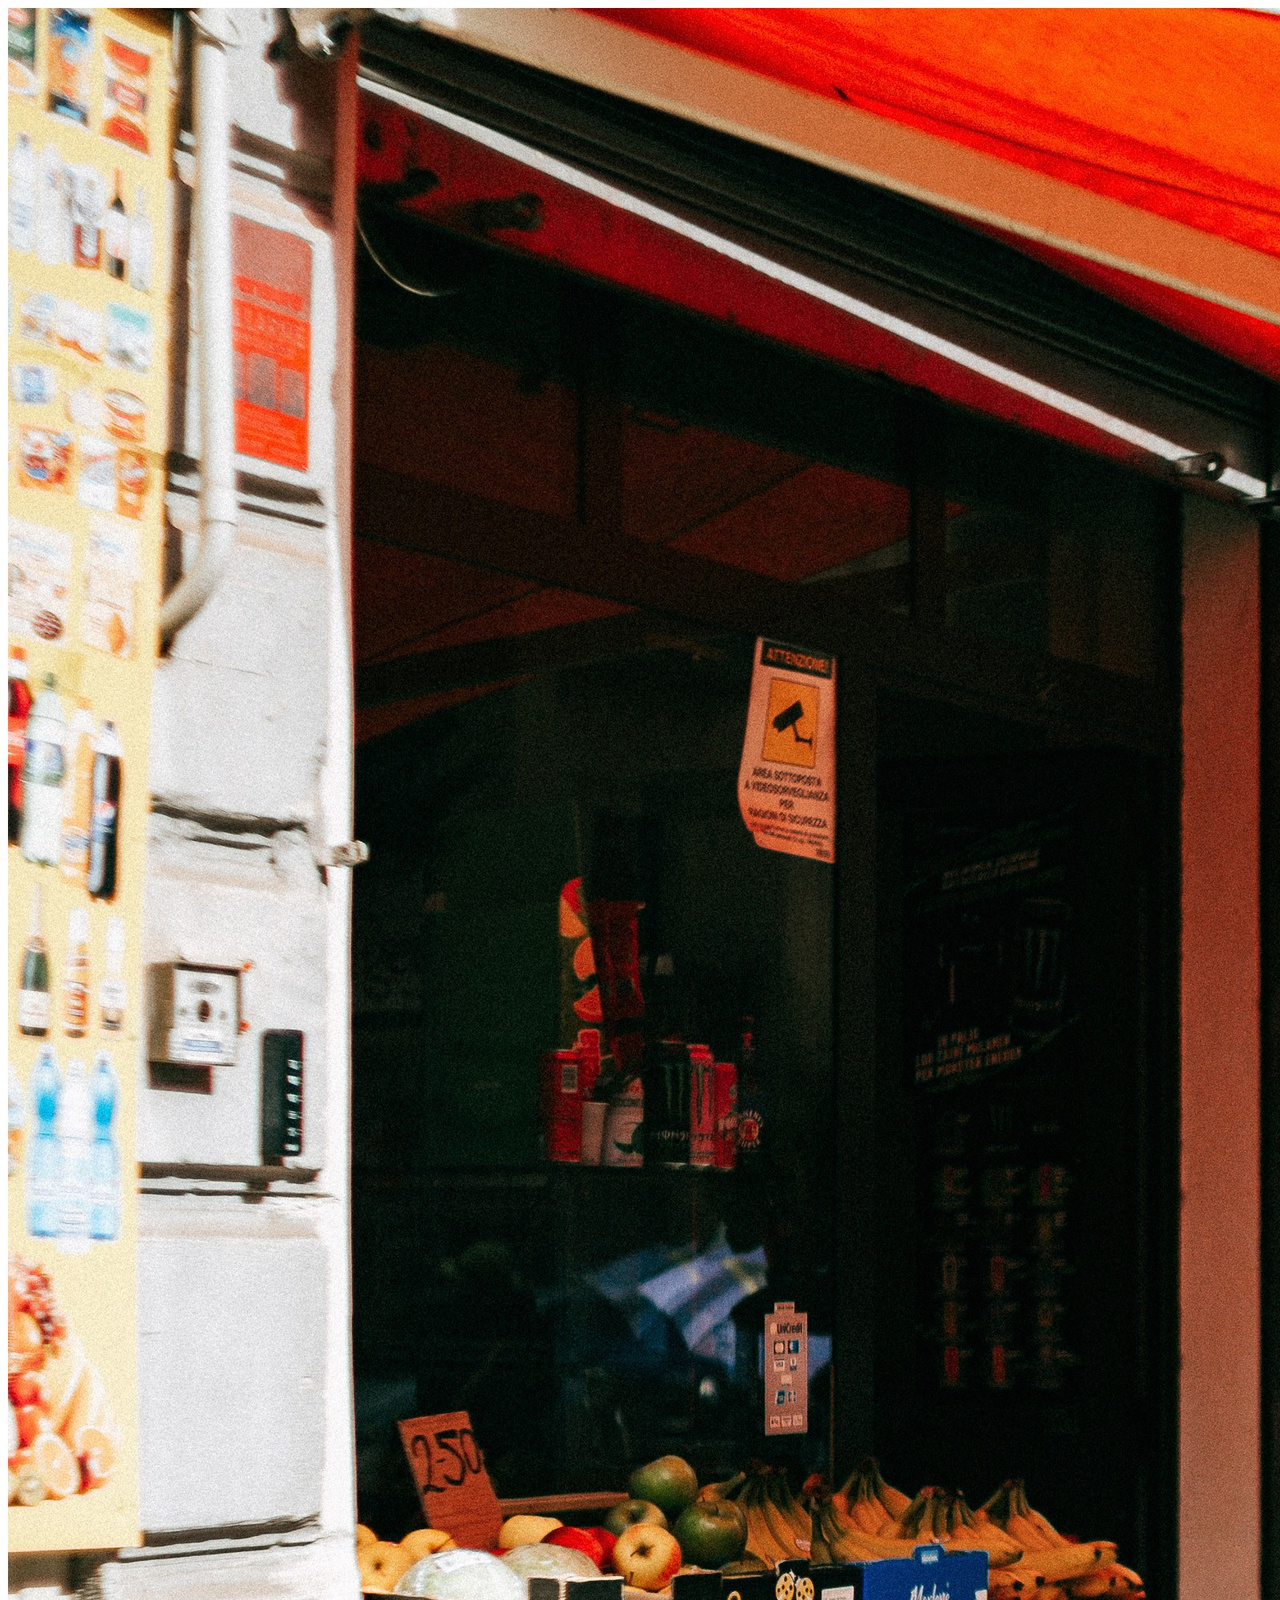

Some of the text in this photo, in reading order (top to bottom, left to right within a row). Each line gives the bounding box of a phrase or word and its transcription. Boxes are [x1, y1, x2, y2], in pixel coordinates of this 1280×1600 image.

[752, 767, 822, 787] AREA SOTTOPOSTA
[744, 780, 829, 802] A VIDEOSORVEGLIANZA
[779, 799, 794, 810] PER
[788, 813, 827, 829] SICUREZZA
